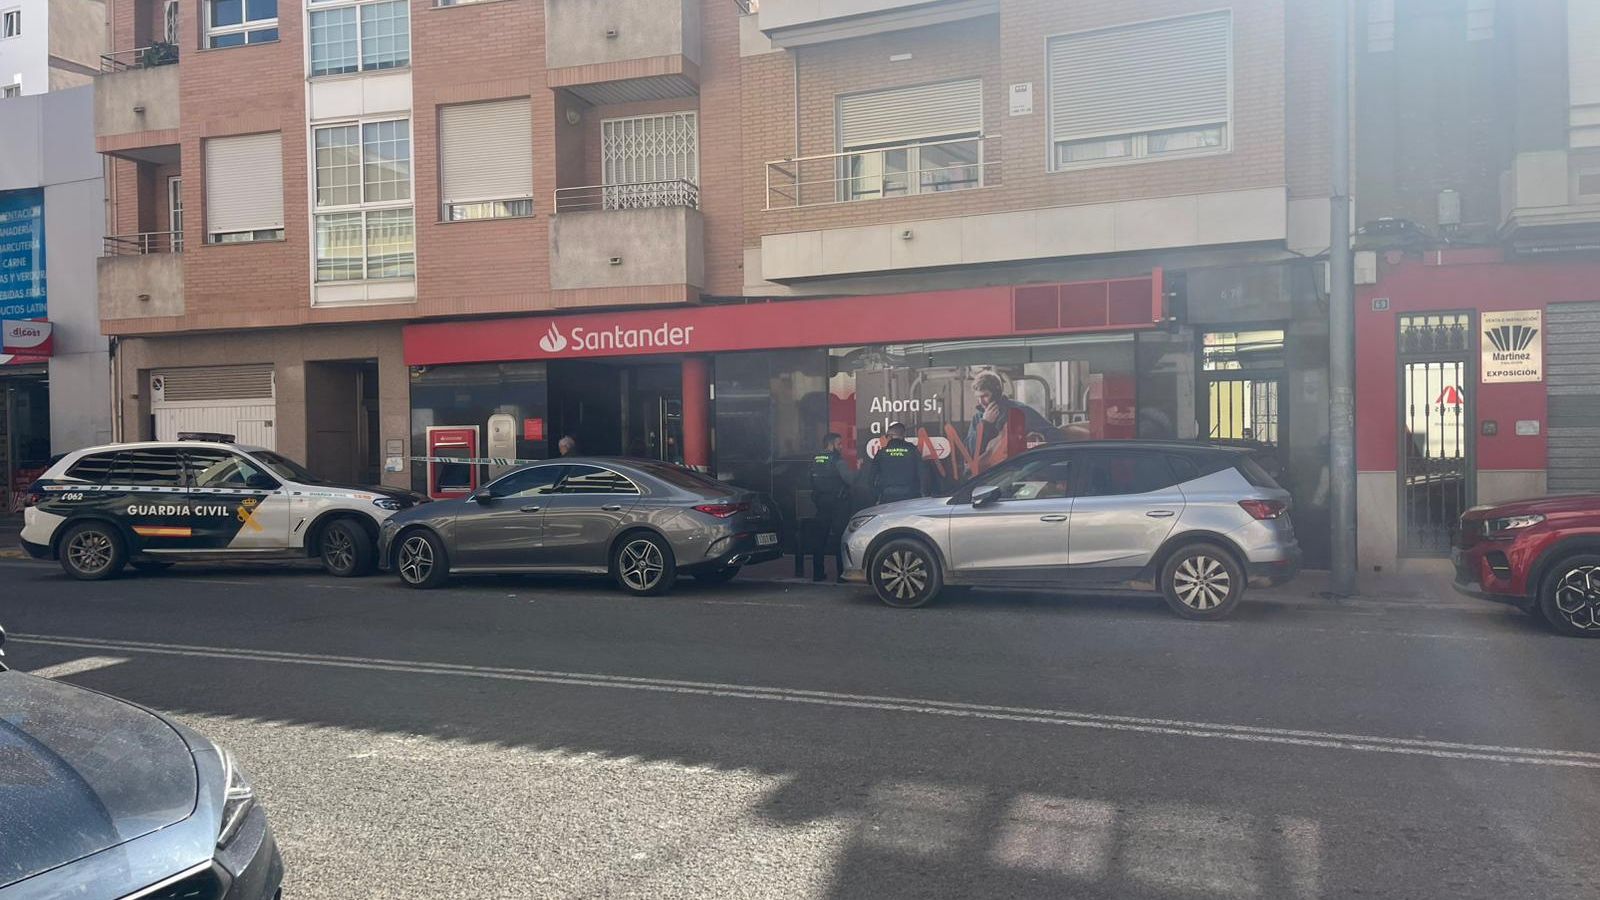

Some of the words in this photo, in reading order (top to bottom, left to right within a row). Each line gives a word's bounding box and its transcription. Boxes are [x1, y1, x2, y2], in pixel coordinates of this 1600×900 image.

[2, 257, 26, 269] CARNE
[571, 322, 694, 351] Santander
[870, 396, 920, 413] Ahora
[923, 393, 942, 414] sí,
[870, 421, 881, 434] a
[885, 417, 899, 434] l
[127, 505, 191, 516] GUARDIA
[194, 505, 229, 517] CIVIL
